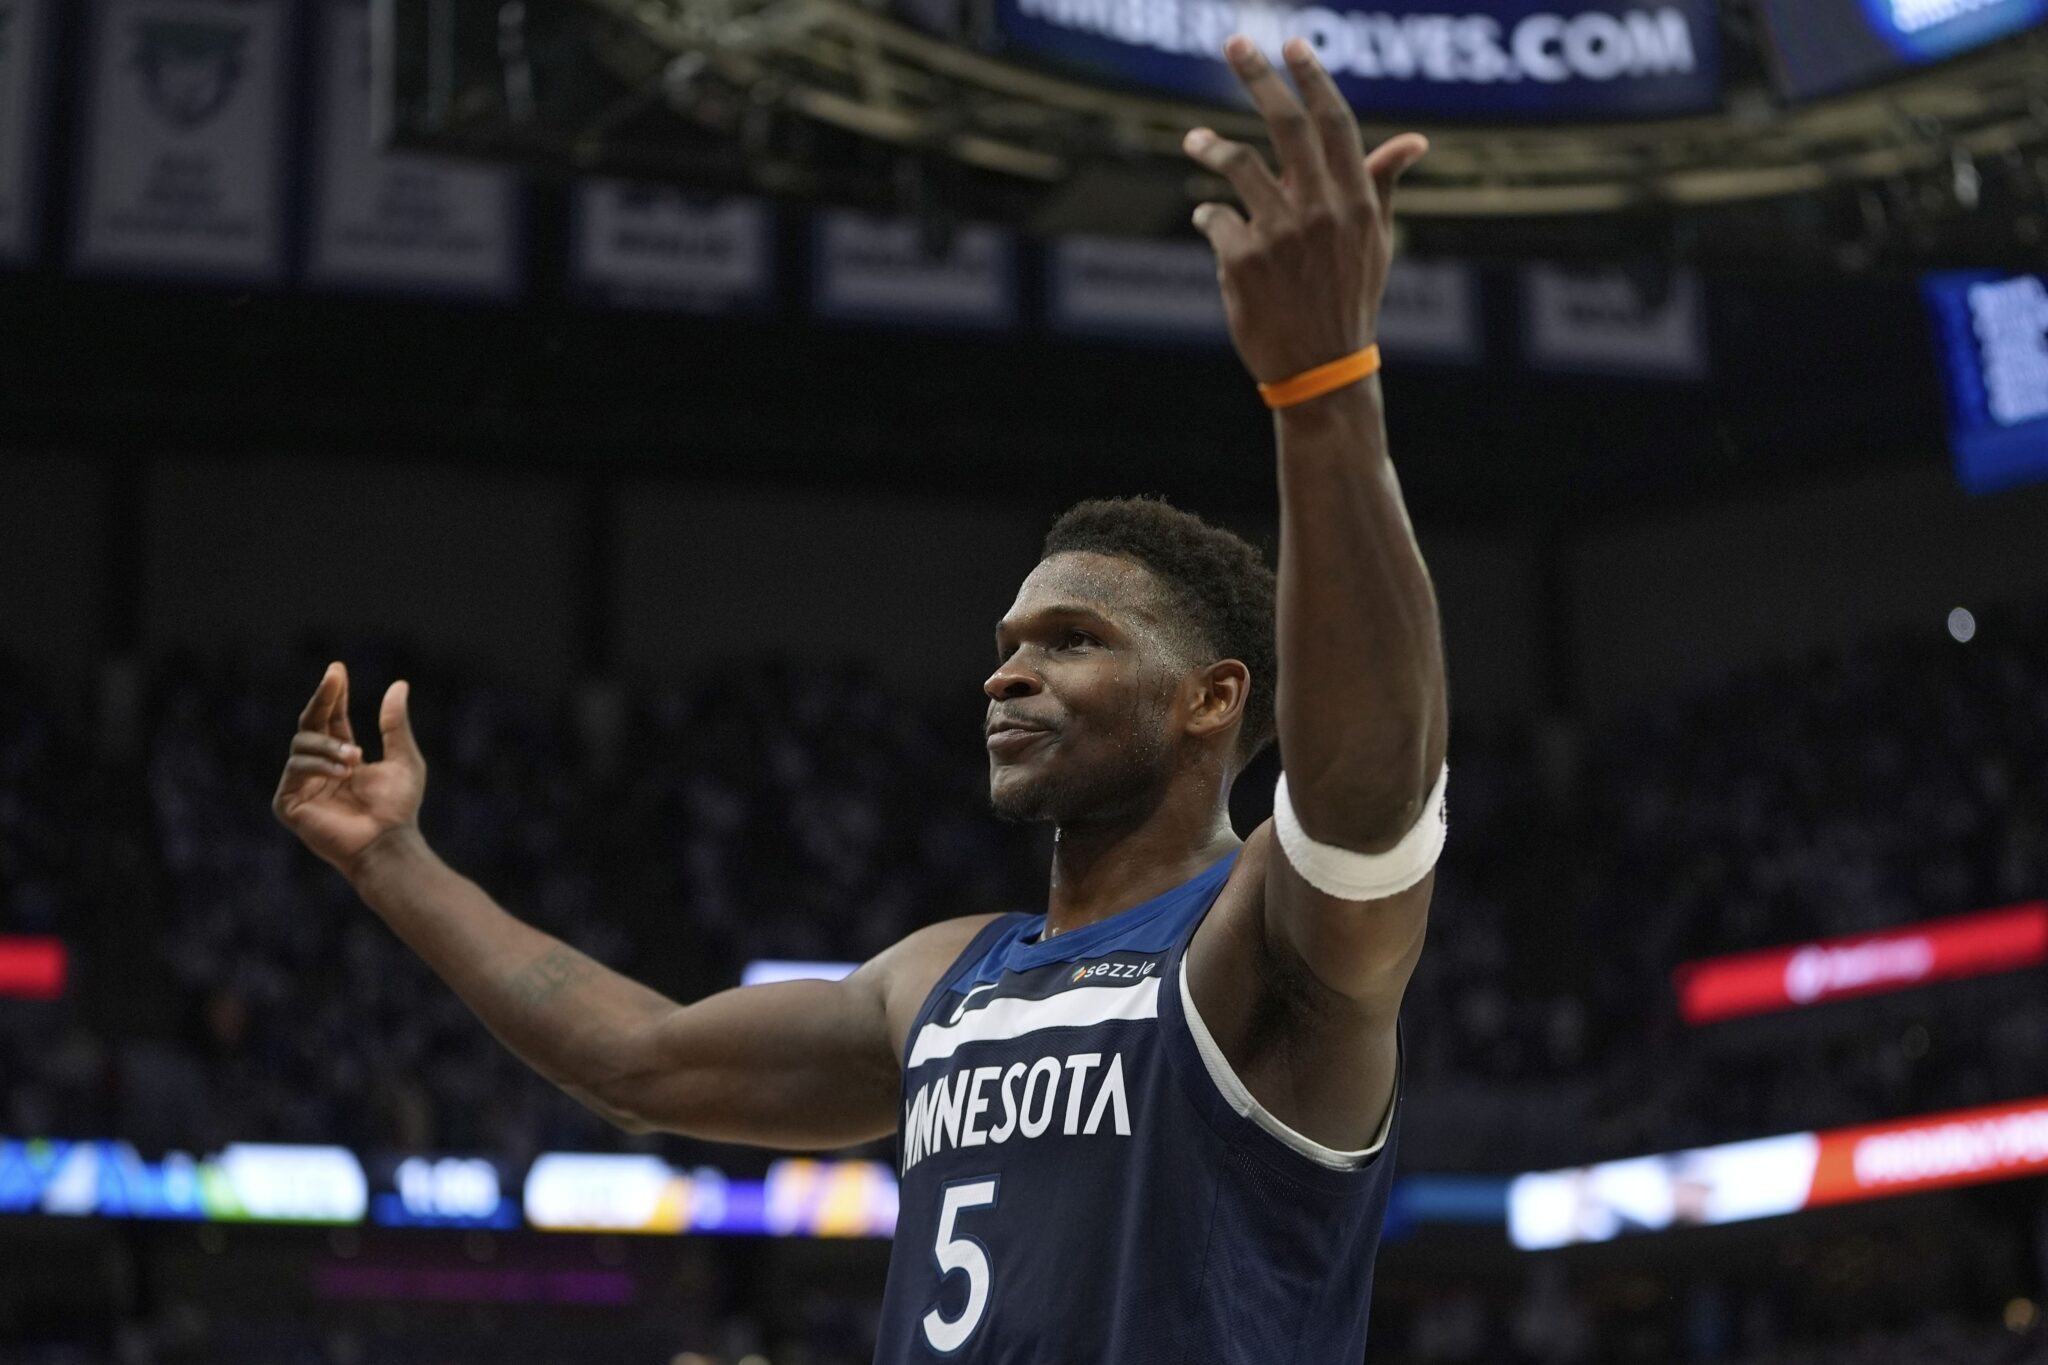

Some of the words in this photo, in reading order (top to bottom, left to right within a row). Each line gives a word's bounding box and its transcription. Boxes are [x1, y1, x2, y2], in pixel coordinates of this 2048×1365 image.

[1084, 961, 1156, 978] sezzle
[901, 1053, 1132, 1178] MINNESOTA
[922, 1178, 997, 1354] 5
